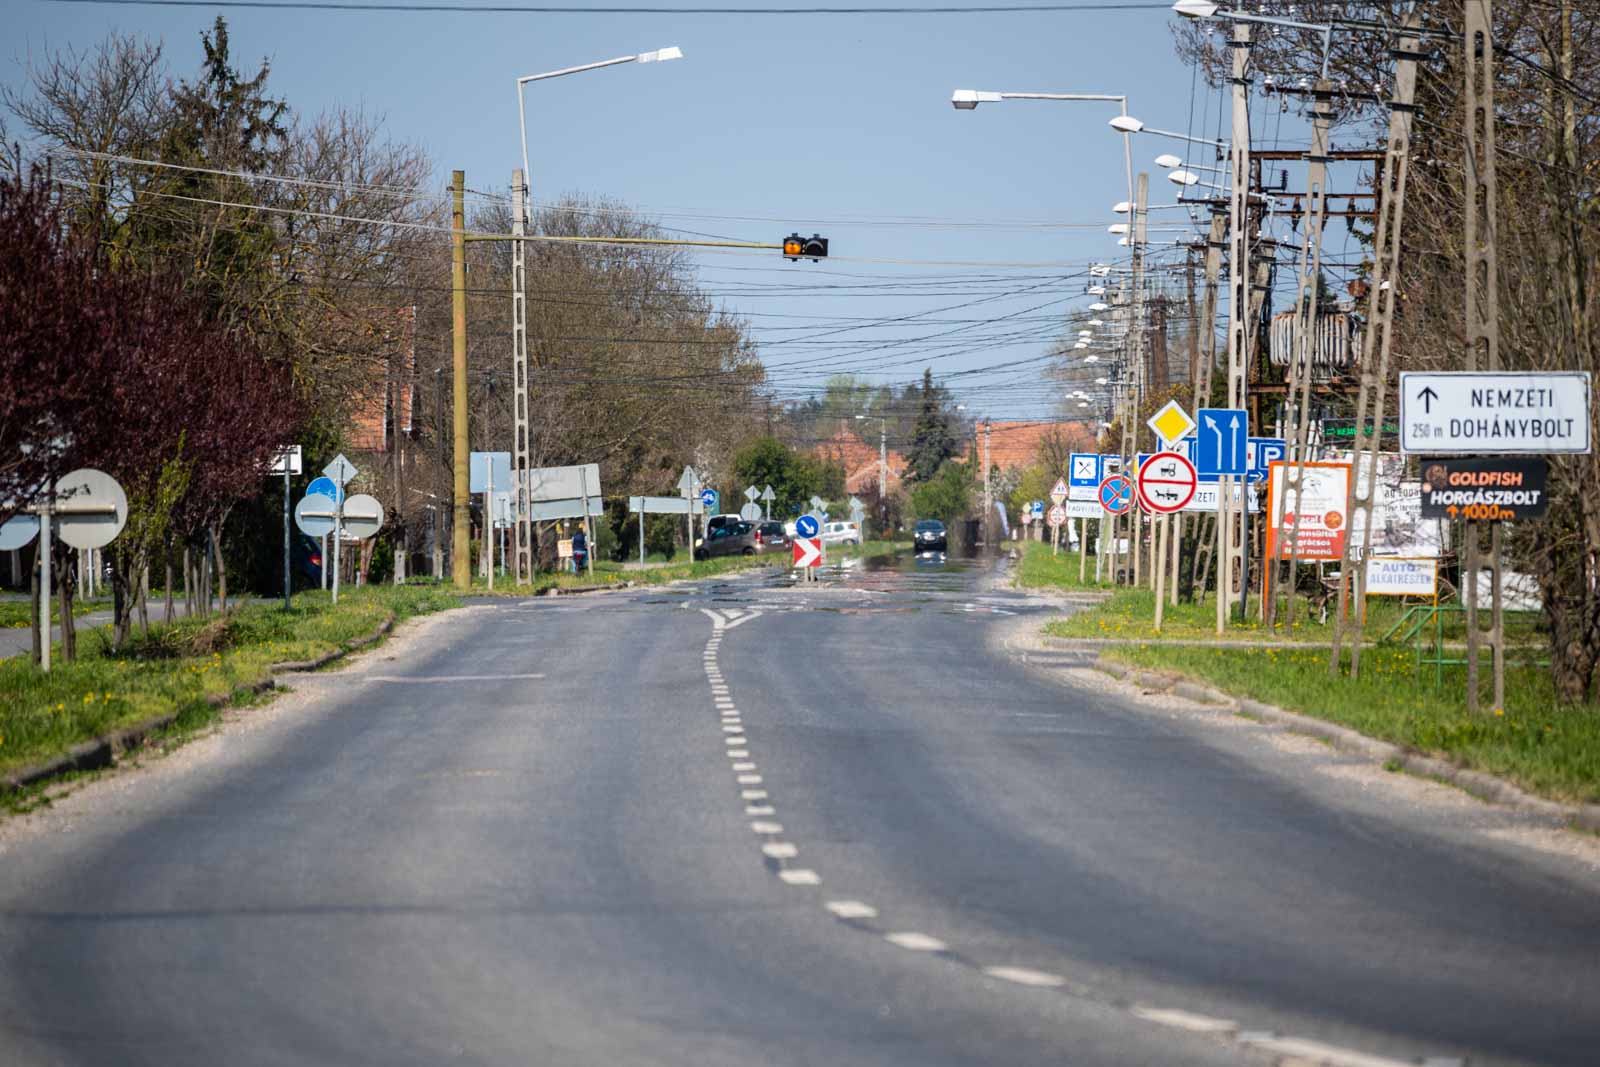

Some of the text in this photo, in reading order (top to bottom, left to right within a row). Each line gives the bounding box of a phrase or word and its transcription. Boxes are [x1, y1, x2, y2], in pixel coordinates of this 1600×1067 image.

[1471, 389, 1553, 408] NEMZETI
[1450, 414, 1574, 438] DOHÁNYBOLT
[1449, 472, 1523, 487] GOLDFISH
[1430, 487, 1540, 505] HORGÁSZBOLT
